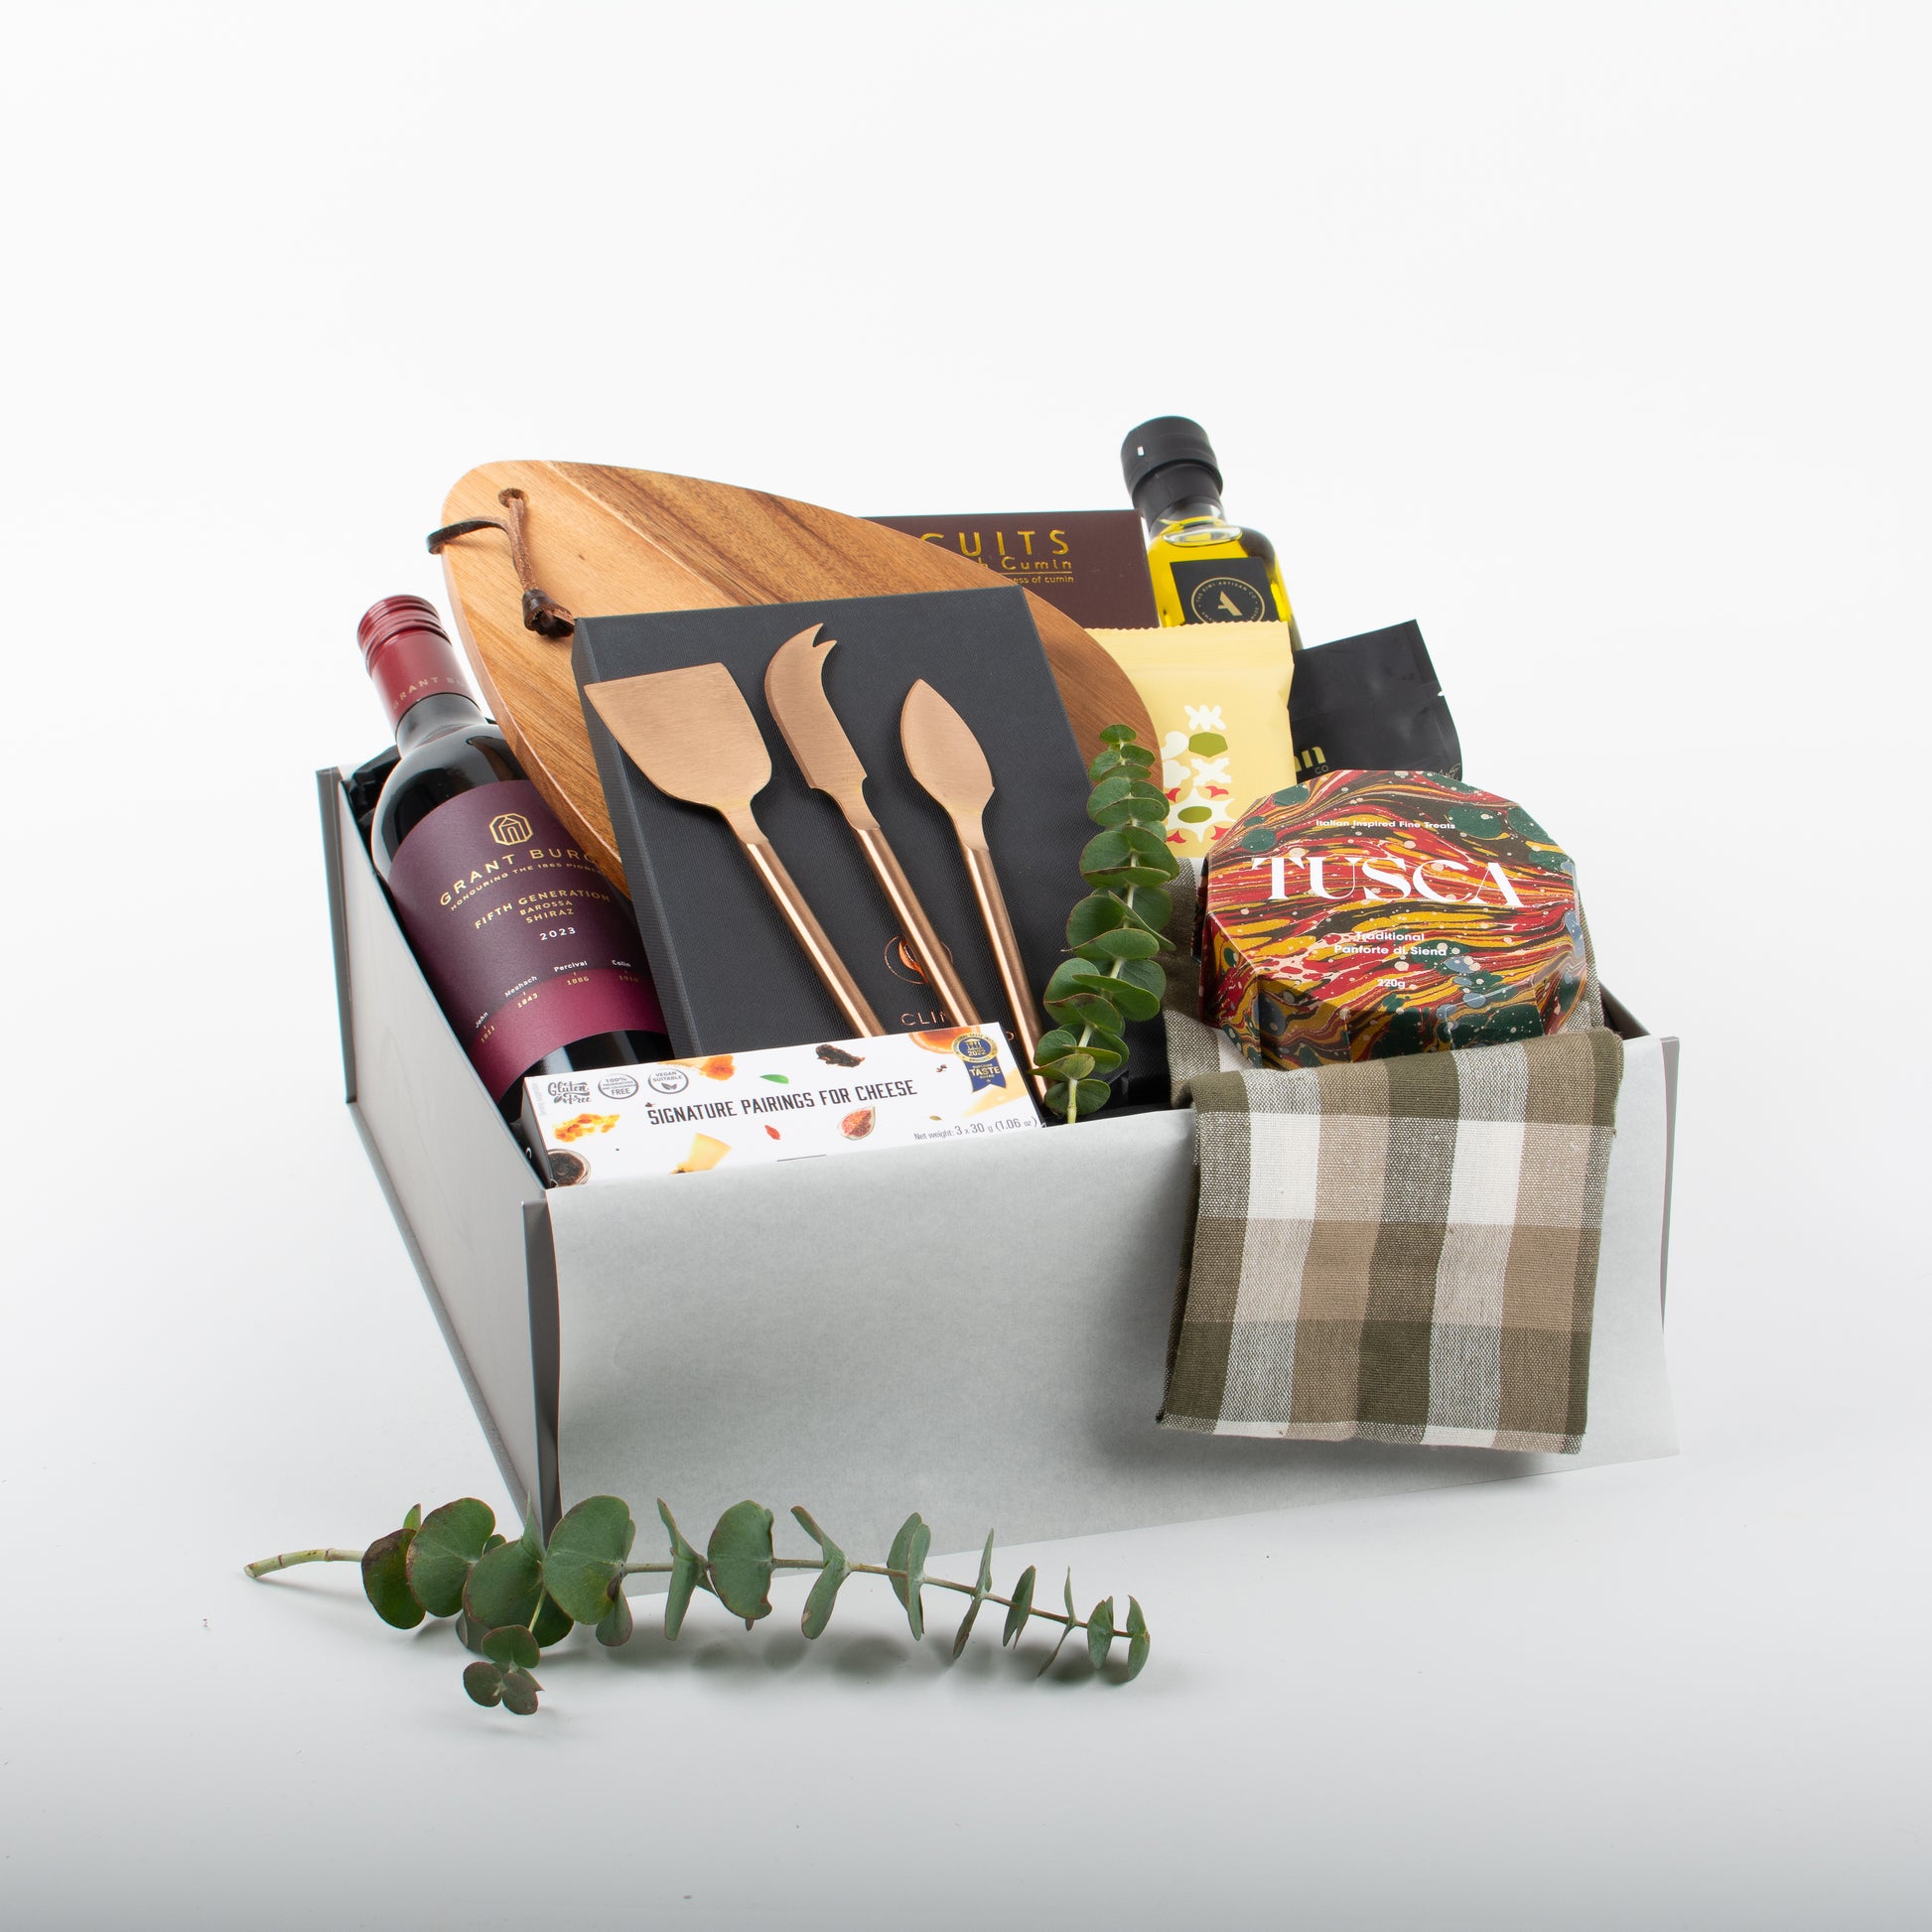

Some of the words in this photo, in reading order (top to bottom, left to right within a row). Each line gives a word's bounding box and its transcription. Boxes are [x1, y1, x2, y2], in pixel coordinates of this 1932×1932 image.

[1001, 556, 1072, 570] Cumin
[393, 677, 439, 709] GRANT
[1314, 764, 1329, 774] CO
[1352, 820, 1396, 829] Inspired
[440, 854, 516, 906] GRANT
[451, 873, 509, 911] HONOURING
[512, 865, 534, 875] THE
[1251, 856, 1527, 907] TUSCA
[475, 902, 513, 929] FIFTH
[518, 890, 612, 904] GENERATION
[519, 899, 574, 915] BAROSSA
[525, 908, 575, 924] SHIRAZ
[539, 926, 577, 941] 2023
[1355, 931, 1425, 942] Traditional
[1333, 944, 1390, 955] Panforte
[1393, 945, 1406, 955] di
[1410, 946, 1447, 956] Siena
[1377, 978, 1406, 990] 220g
[477, 1012, 488, 1029] John
[504, 976, 538, 998] Meshach
[554, 960, 588, 973] Percival
[612, 959, 631, 968] Colin
[517, 993, 538, 1009] 1843
[969, 1066, 1001, 1077] TASTE
[547, 1081, 591, 1096] Gluten
[563, 1094, 593, 1104] Free
[646, 1100, 739, 1126] SIGNATURE
[743, 1092, 815, 1115] PAIRINGS
[819, 1087, 852, 1106] FOR
[854, 1079, 918, 1102] CHEESE
[928, 1130, 954, 1140] weight:
[954, 1125, 963, 1136] 3
[970, 1122, 985, 1134] 30
[995, 1118, 1022, 1132] (1.06
